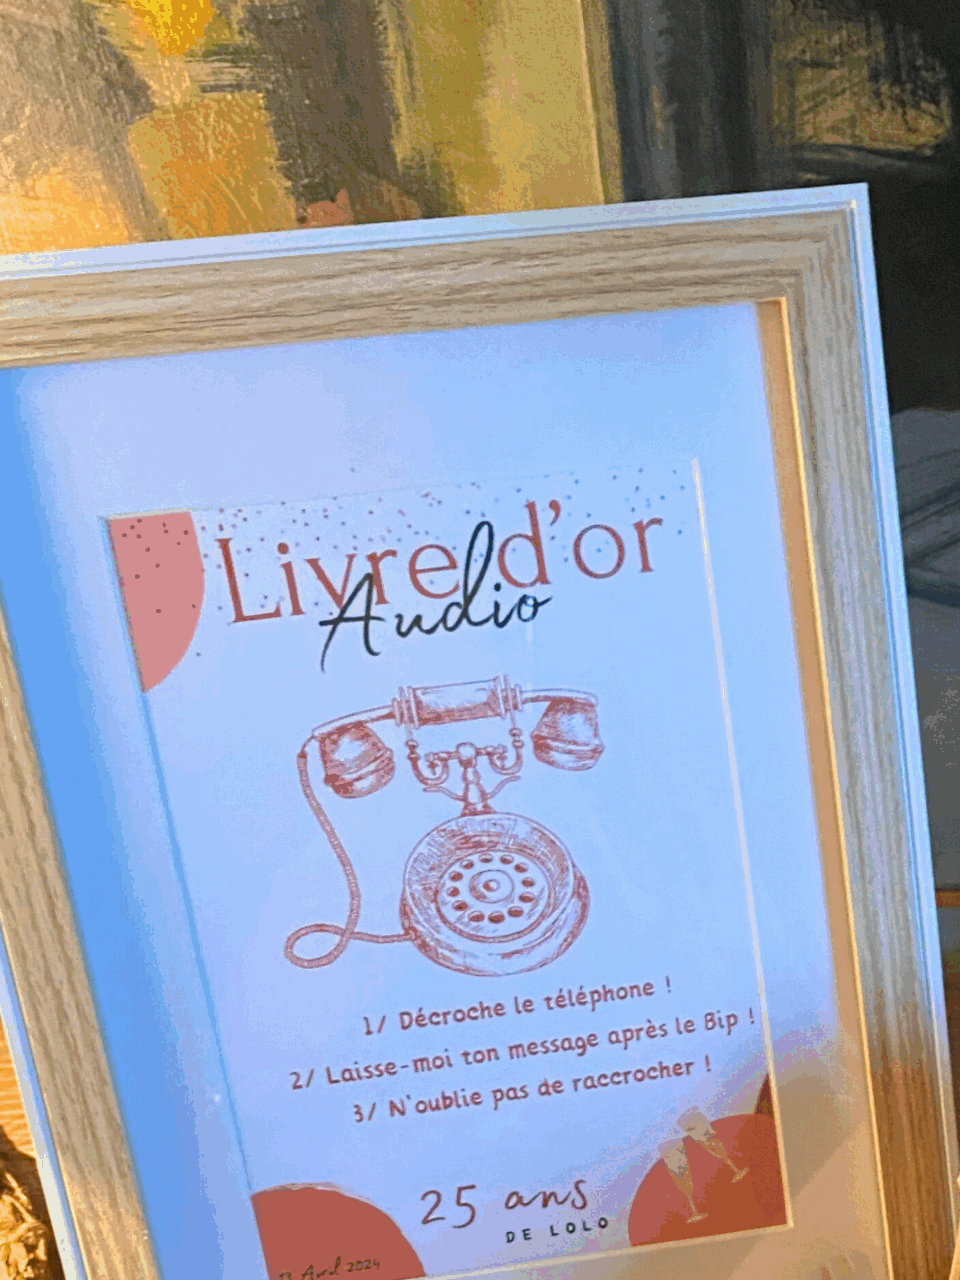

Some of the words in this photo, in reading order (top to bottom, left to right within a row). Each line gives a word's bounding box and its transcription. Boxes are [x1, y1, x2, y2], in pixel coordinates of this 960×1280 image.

[213, 536, 462, 624] Livre
[319, 520, 553, 673] Audio
[363, 1015, 386, 1036] 1/
[399, 1001, 506, 1031] Décroche
[514, 996, 535, 1014] le
[544, 981, 655, 1012] téléphone
[665, 975, 672, 993] !
[290, 1068, 314, 1090] 2/
[326, 1048, 453, 1084] Laisse-moi
[461, 1047, 500, 1065] ton
[508, 1033, 599, 1060] message
[608, 1019, 668, 1050] après
[675, 1017, 696, 1036] le
[704, 1010, 738, 1036] Bip
[748, 1007, 756, 1024] !
[353, 1102, 376, 1123] 3/
[388, 1088, 483, 1117] N'oublie
[492, 1085, 529, 1111] pas
[538, 1078, 564, 1096] de
[572, 1061, 695, 1092] raccrocher
[704, 1054, 711, 1072] !
[421, 1184, 477, 1229] 25
[504, 1179, 588, 1210] ans
[505, 1228, 533, 1244] DE
[549, 1217, 609, 1237] LOLO
[347, 1258, 381, 1273] 2024
